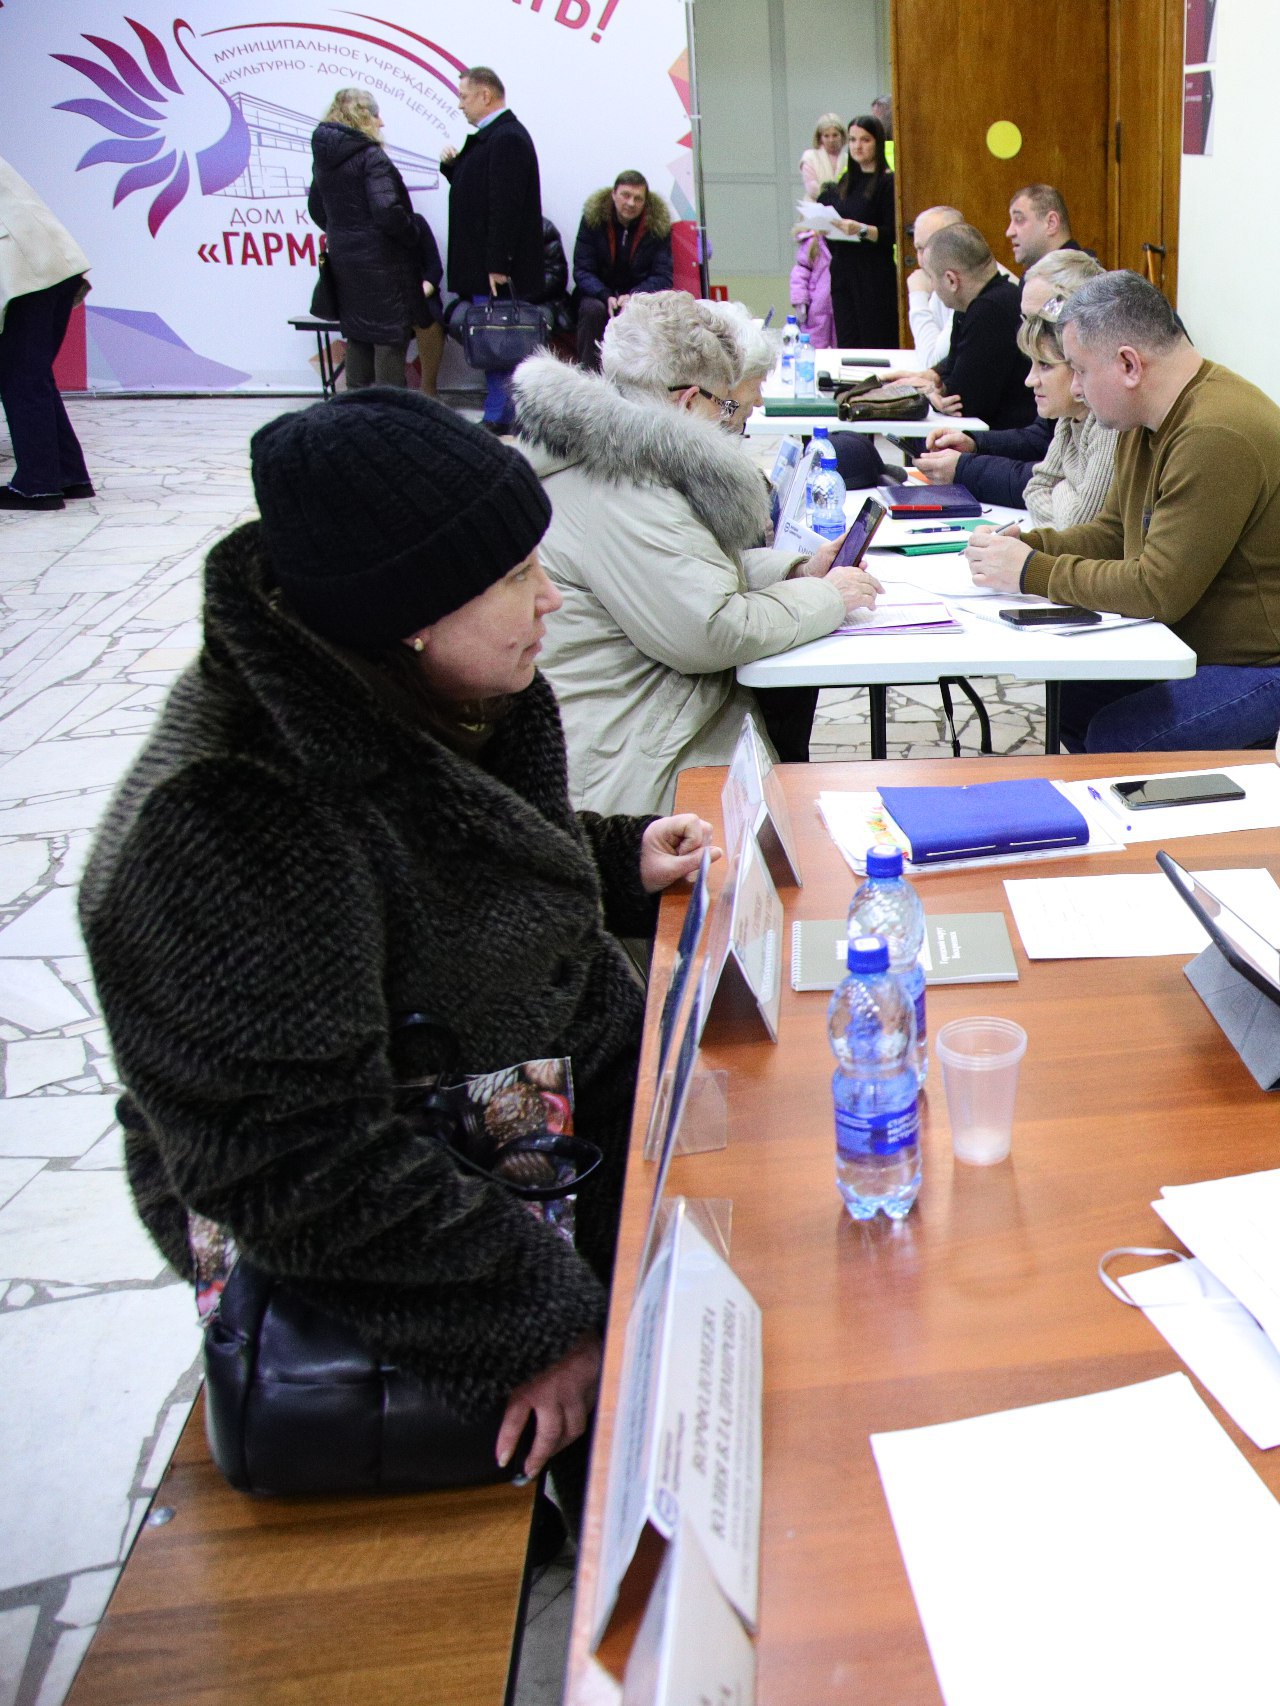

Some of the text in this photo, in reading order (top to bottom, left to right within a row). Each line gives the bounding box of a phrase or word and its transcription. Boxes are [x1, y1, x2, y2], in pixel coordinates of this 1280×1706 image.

[214, 39, 461, 121] МУНИЦИПАЛЬНОЕ УЧРЕЖДЕНИЕ
[218, 59, 306, 86] «КУЛЬТУРНО
[317, 62, 405, 99] ДОСУГОВЫЙ
[406, 98, 451, 140] ЦЕНТР»
[230, 207, 284, 227] ДОМ
